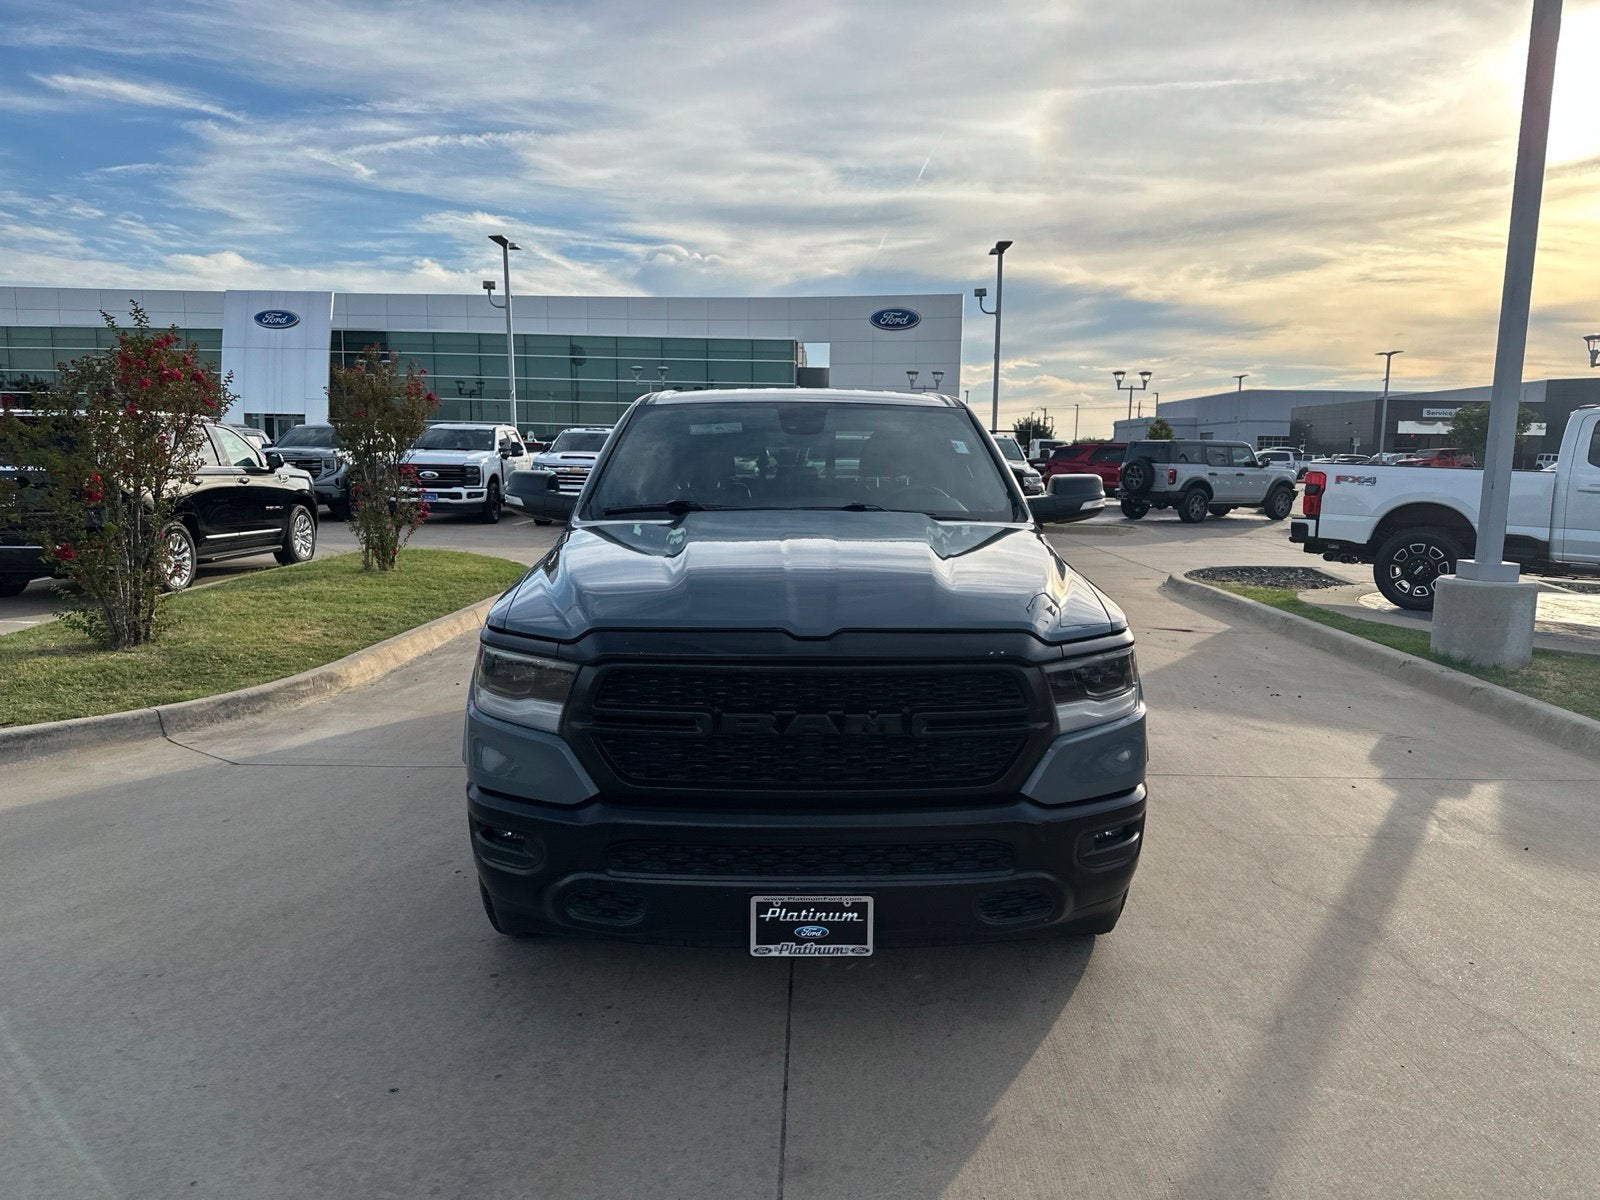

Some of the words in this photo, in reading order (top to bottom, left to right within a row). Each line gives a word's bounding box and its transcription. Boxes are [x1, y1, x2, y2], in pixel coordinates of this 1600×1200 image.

[262, 313, 288, 324] Ford
[880, 312, 910, 325] Ford
[1426, 409, 1453, 417] Service
[1335, 475, 1377, 485] FX4
[721, 713, 903, 736] RAM
[759, 908, 864, 922] Platinum
[800, 928, 822, 937] Ford
[780, 943, 844, 955] Platinum
